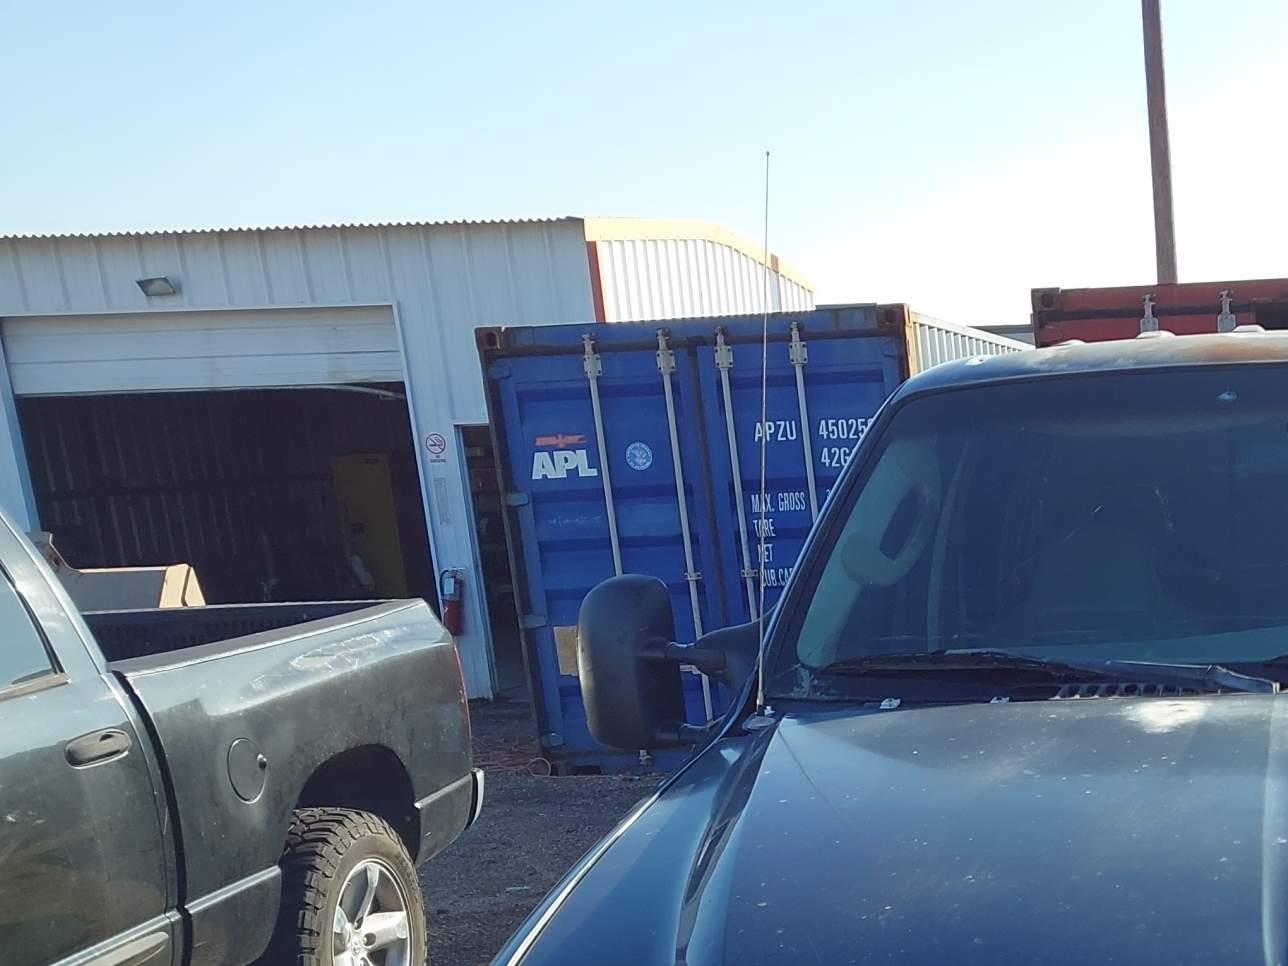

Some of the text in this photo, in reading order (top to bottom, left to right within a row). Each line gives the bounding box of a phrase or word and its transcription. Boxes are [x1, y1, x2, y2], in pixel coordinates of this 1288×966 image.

[755, 420, 797, 442] APZU
[531, 449, 598, 480] APL
[777, 491, 806, 512] GROSS
